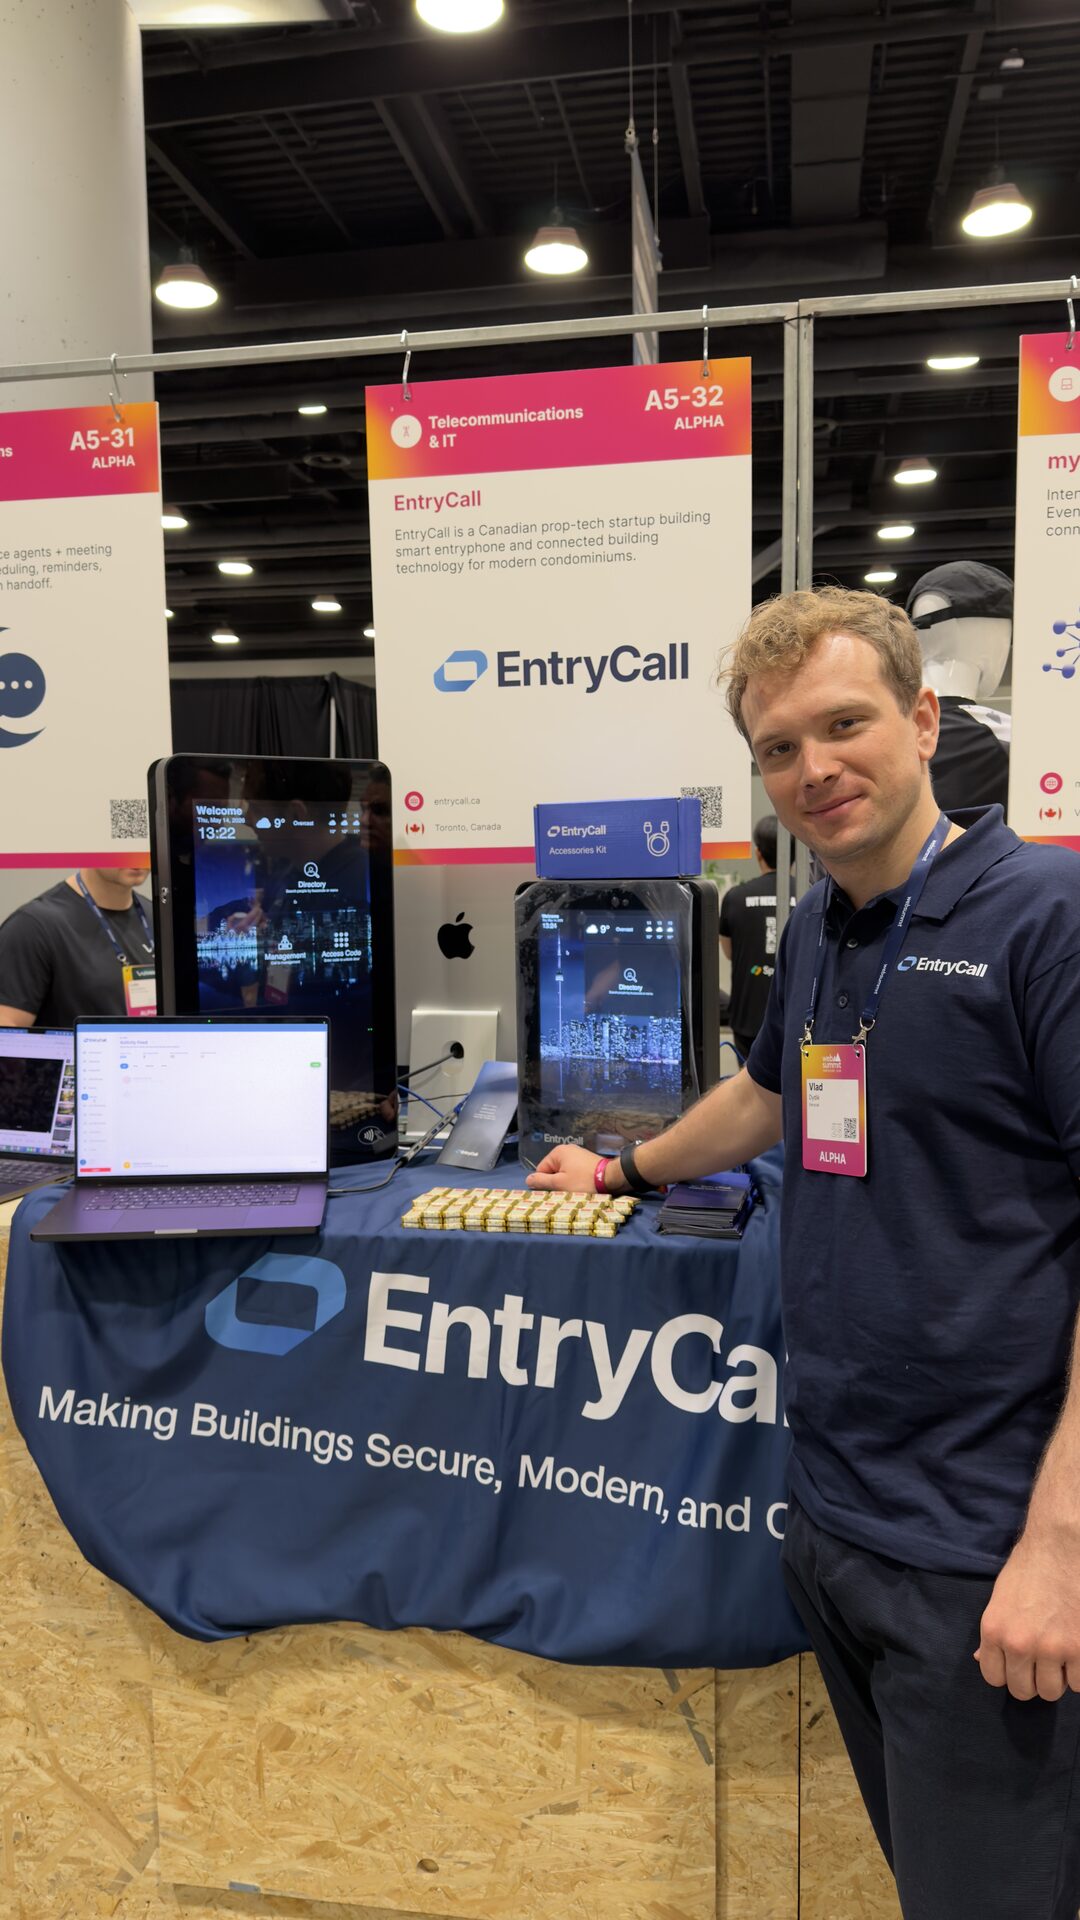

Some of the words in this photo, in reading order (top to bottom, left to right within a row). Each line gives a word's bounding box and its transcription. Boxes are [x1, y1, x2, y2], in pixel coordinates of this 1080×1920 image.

[644, 385, 724, 412] A5-32
[428, 406, 584, 429] Telecommunications
[674, 414, 724, 431] ALPHA
[70, 427, 134, 451] A5-31
[428, 436, 440, 449] &
[442, 434, 457, 448] IT
[92, 454, 135, 469] ALPHA
[394, 490, 481, 513] EntryCall
[395, 527, 450, 542] EntryCall
[454, 526, 464, 537] is
[467, 526, 475, 536] a
[479, 521, 537, 536] Canadian
[541, 517, 605, 535] prop-tech
[608, 515, 655, 529] startup
[659, 510, 711, 525] building
[13, 548, 52, 561] agents
[66, 543, 112, 557] meeting
[395, 545, 431, 558] smart
[434, 541, 506, 557] entryphone
[509, 539, 533, 551] and
[536, 534, 604, 550] connected
[608, 531, 659, 546] building
[42, 559, 102, 574] reminders,
[396, 561, 465, 575] technology
[468, 558, 486, 570] for
[489, 556, 537, 570] modern
[540, 551, 637, 567] condominiums.
[6, 578, 53, 592] handoff.
[497, 642, 689, 693] EntryCall
[434, 797, 481, 807] entrycall.ca
[196, 805, 243, 816] Welcome
[197, 816, 210, 824] Thu,
[210, 817, 222, 825] May
[273, 817, 286, 829] 9°
[435, 823, 469, 832] Toronto,
[470, 823, 502, 831] Canada
[198, 826, 237, 840] 13:22
[561, 825, 607, 838] EntryCall
[549, 847, 594, 855] Accessories
[298, 880, 327, 889] Directory
[265, 951, 306, 961] Management
[322, 950, 344, 958] Access
[345, 949, 362, 957] Code
[916, 957, 988, 977] EntryCall
[809, 1082, 823, 1091] Vlad
[544, 1133, 584, 1146] EntryCall
[819, 1151, 846, 1165] ALPHA
[363, 1271, 789, 1427] EntryCa
[38, 1386, 178, 1441] Making
[190, 1402, 354, 1465] Buildings
[364, 1433, 502, 1494] Secure,
[518, 1454, 670, 1524] Modern,
[677, 1496, 751, 1533] and
